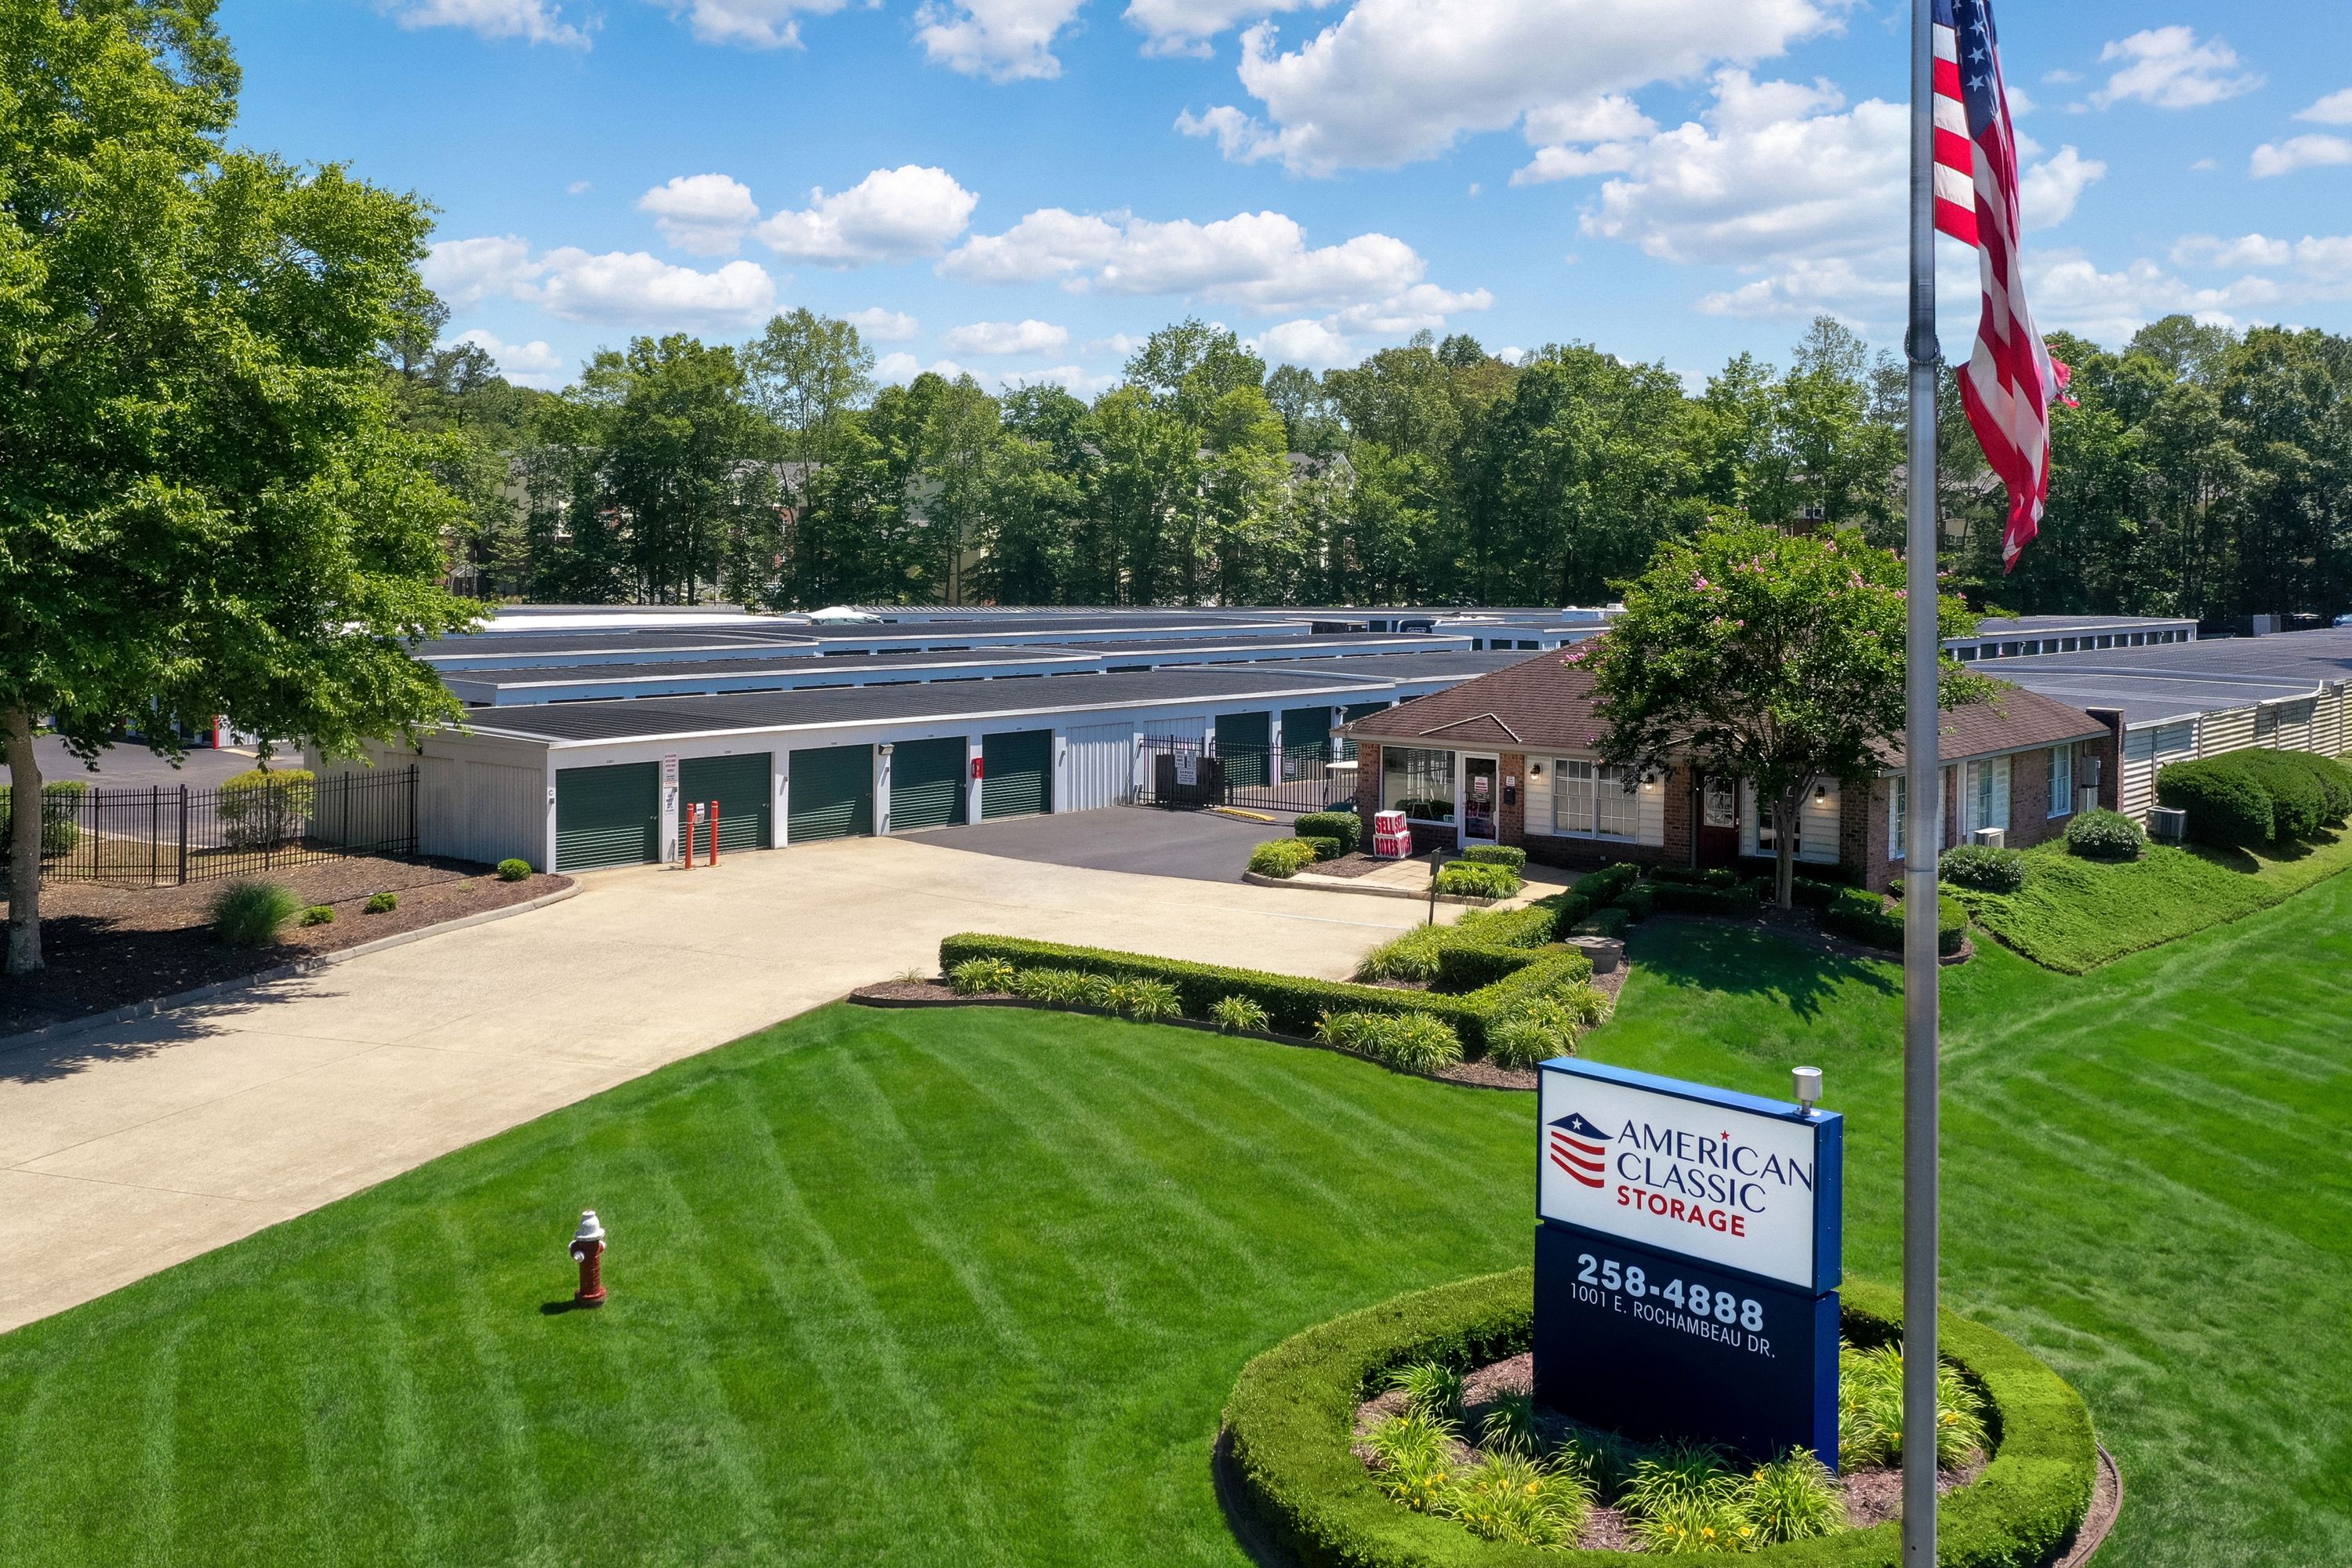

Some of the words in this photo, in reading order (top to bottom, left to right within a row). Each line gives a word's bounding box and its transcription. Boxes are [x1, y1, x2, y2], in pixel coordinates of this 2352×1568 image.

[1375, 838, 1399, 857] BOXES
[1376, 816, 1395, 834] SELL
[1395, 813, 1406, 834] SELL
[1617, 1120, 1813, 1192] AMERICAN
[1617, 1152, 1766, 1213] CLASSIC
[1617, 1185, 1745, 1238] STORAGE
[1571, 1283, 1606, 1307] 1001
[1614, 1295, 1627, 1314] E.
[1634, 1301, 1740, 1347] ROCHAMBEAU
[1748, 1334, 1775, 1358] DR.
[1577, 1254, 1764, 1332] 258-4888
